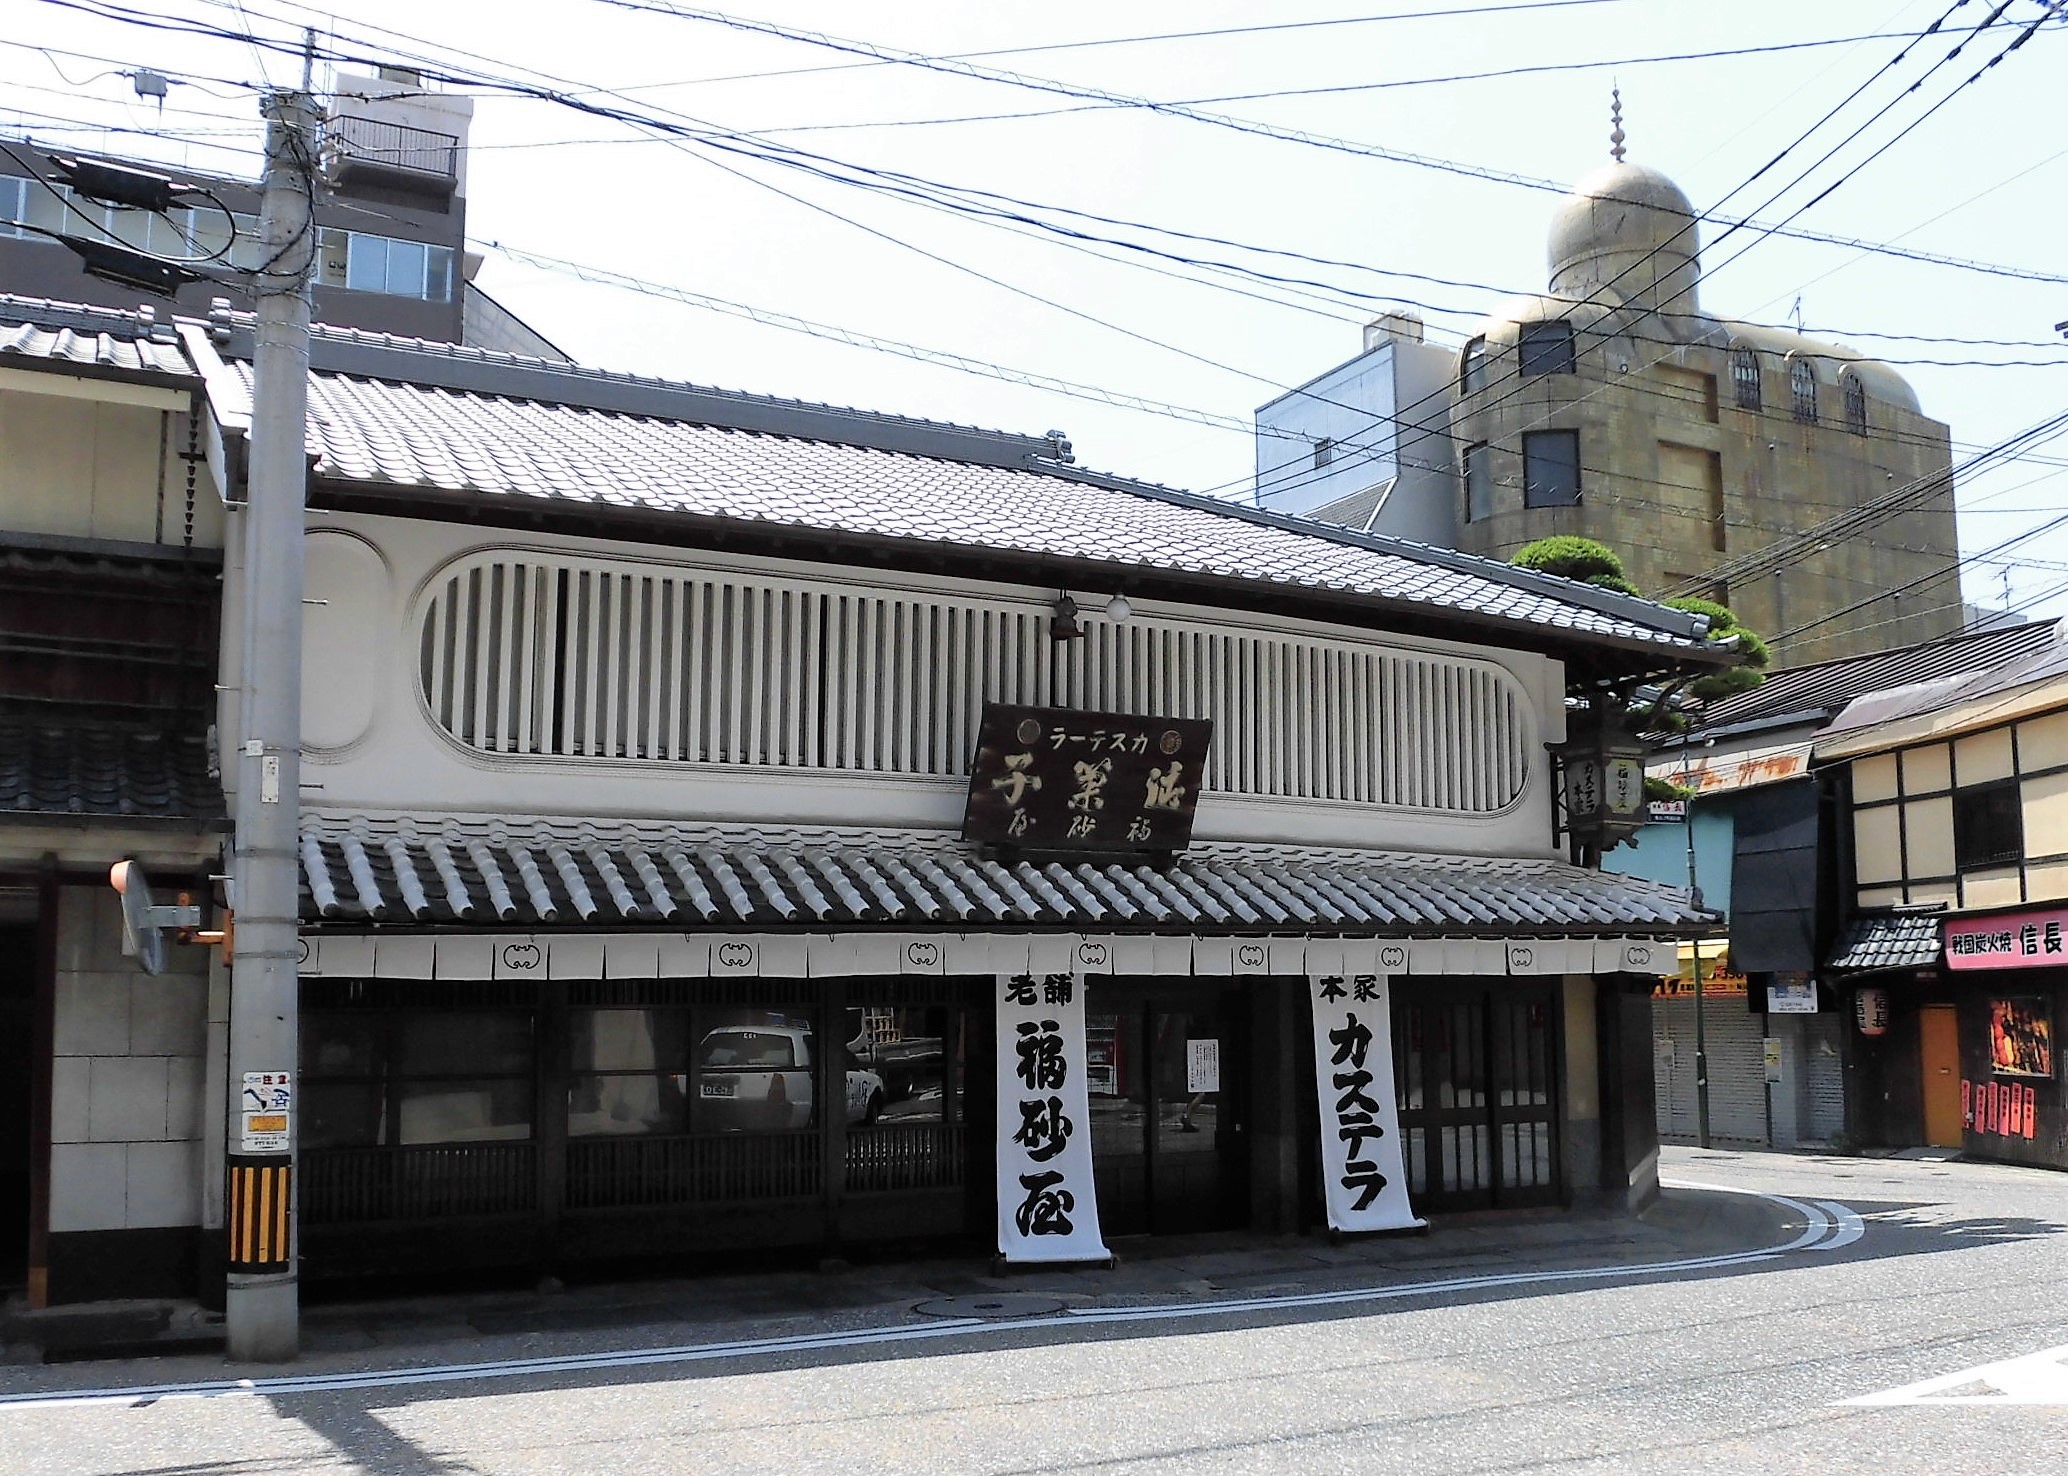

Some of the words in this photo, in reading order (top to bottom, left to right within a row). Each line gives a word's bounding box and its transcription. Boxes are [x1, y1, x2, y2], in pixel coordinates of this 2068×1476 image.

[1951, 931, 2013, 956] 戦国炭火焼
[2019, 921, 2063, 956] 信長
[1004, 974, 1075, 1007] 老舗
[1319, 975, 1381, 1004] 本家
[1013, 1019, 1075, 1237] 福砂屋
[1328, 1012, 1388, 1211] カステラ
